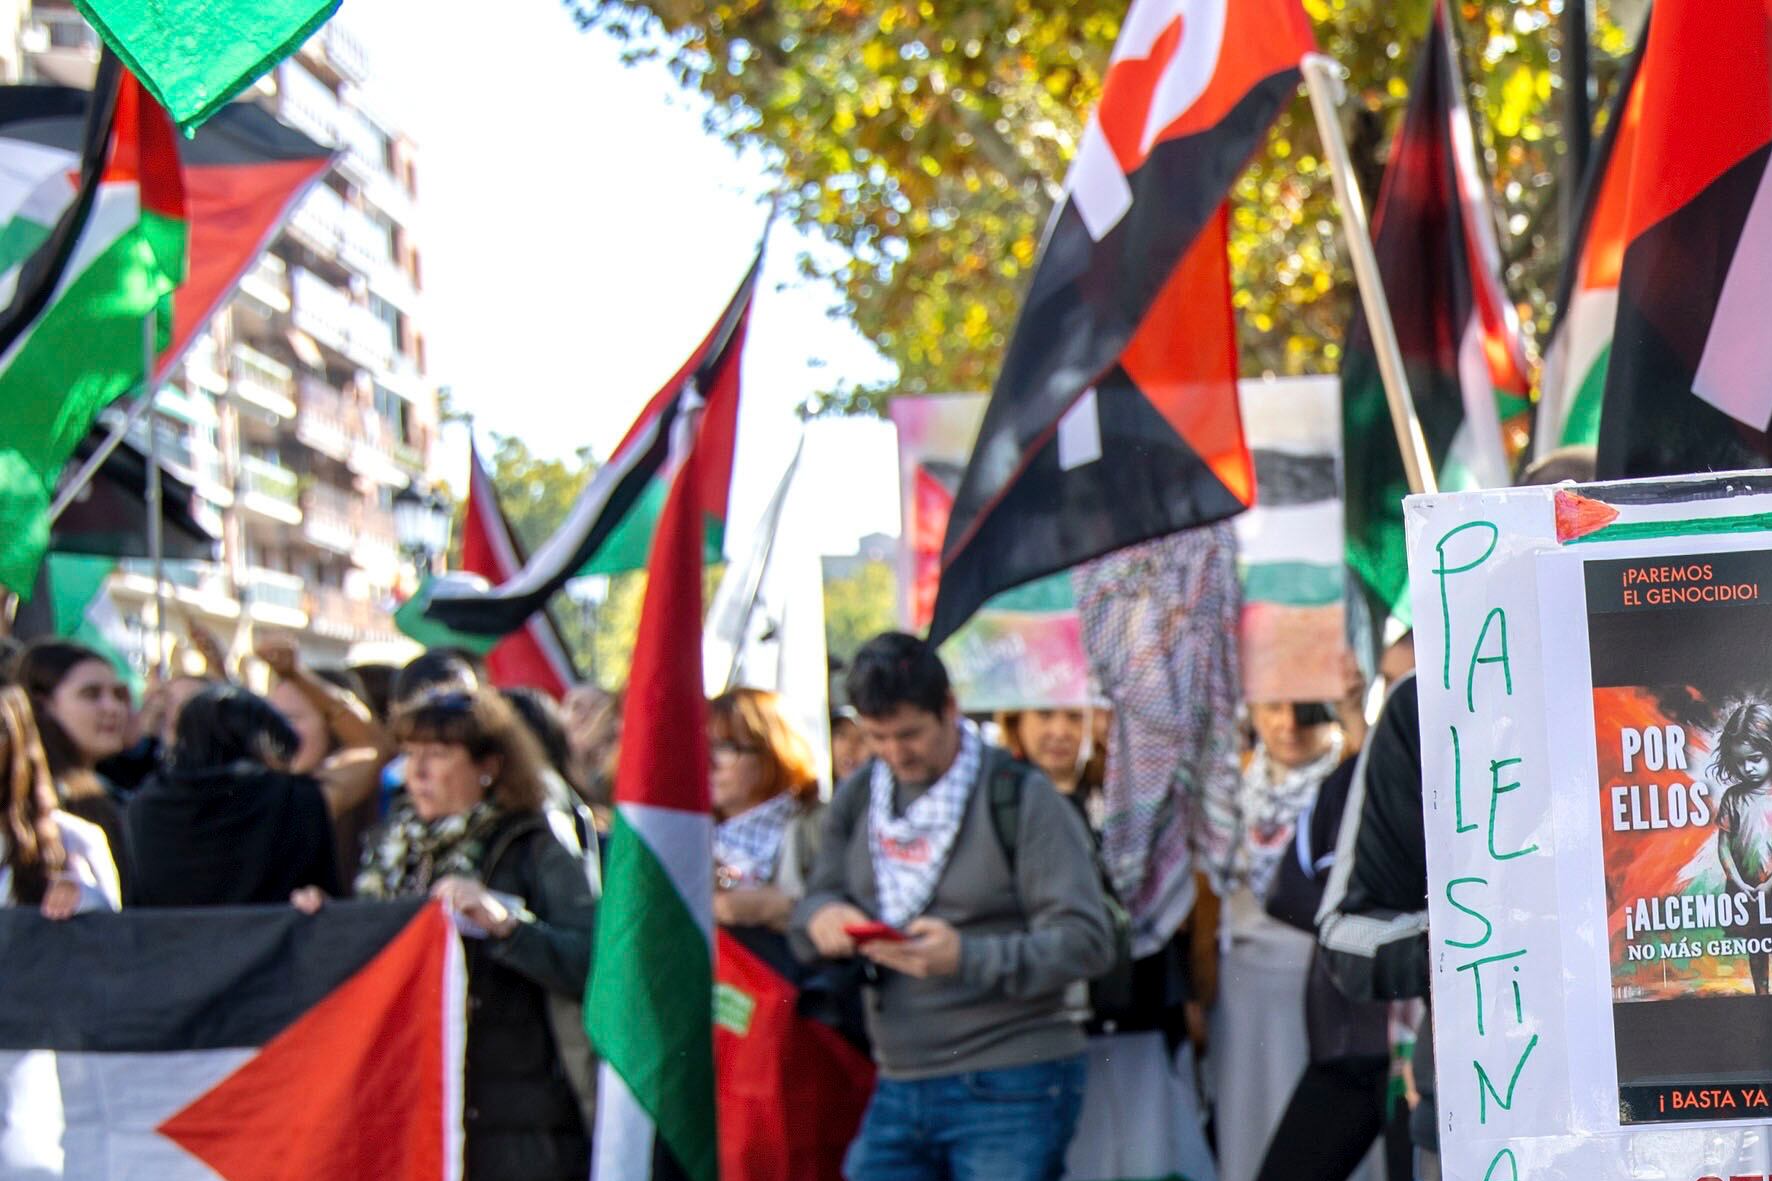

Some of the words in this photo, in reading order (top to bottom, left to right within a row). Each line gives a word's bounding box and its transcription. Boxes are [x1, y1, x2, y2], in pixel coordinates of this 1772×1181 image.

[1622, 565, 1713, 587] ¡PAREMOS
[1624, 590, 1642, 606] EL
[1646, 584, 1759, 605] GENOCIDIO!
[1621, 724, 1688, 773] POR
[1611, 782, 1710, 831] ELLOS
[1625, 892, 1749, 940] ¡ALCEMOS
[1628, 942, 1656, 961] NO
[1659, 937, 1702, 959] MÁS
[1672, 1089, 1736, 1110] BASTA
[1740, 1088, 1769, 1107] YA
